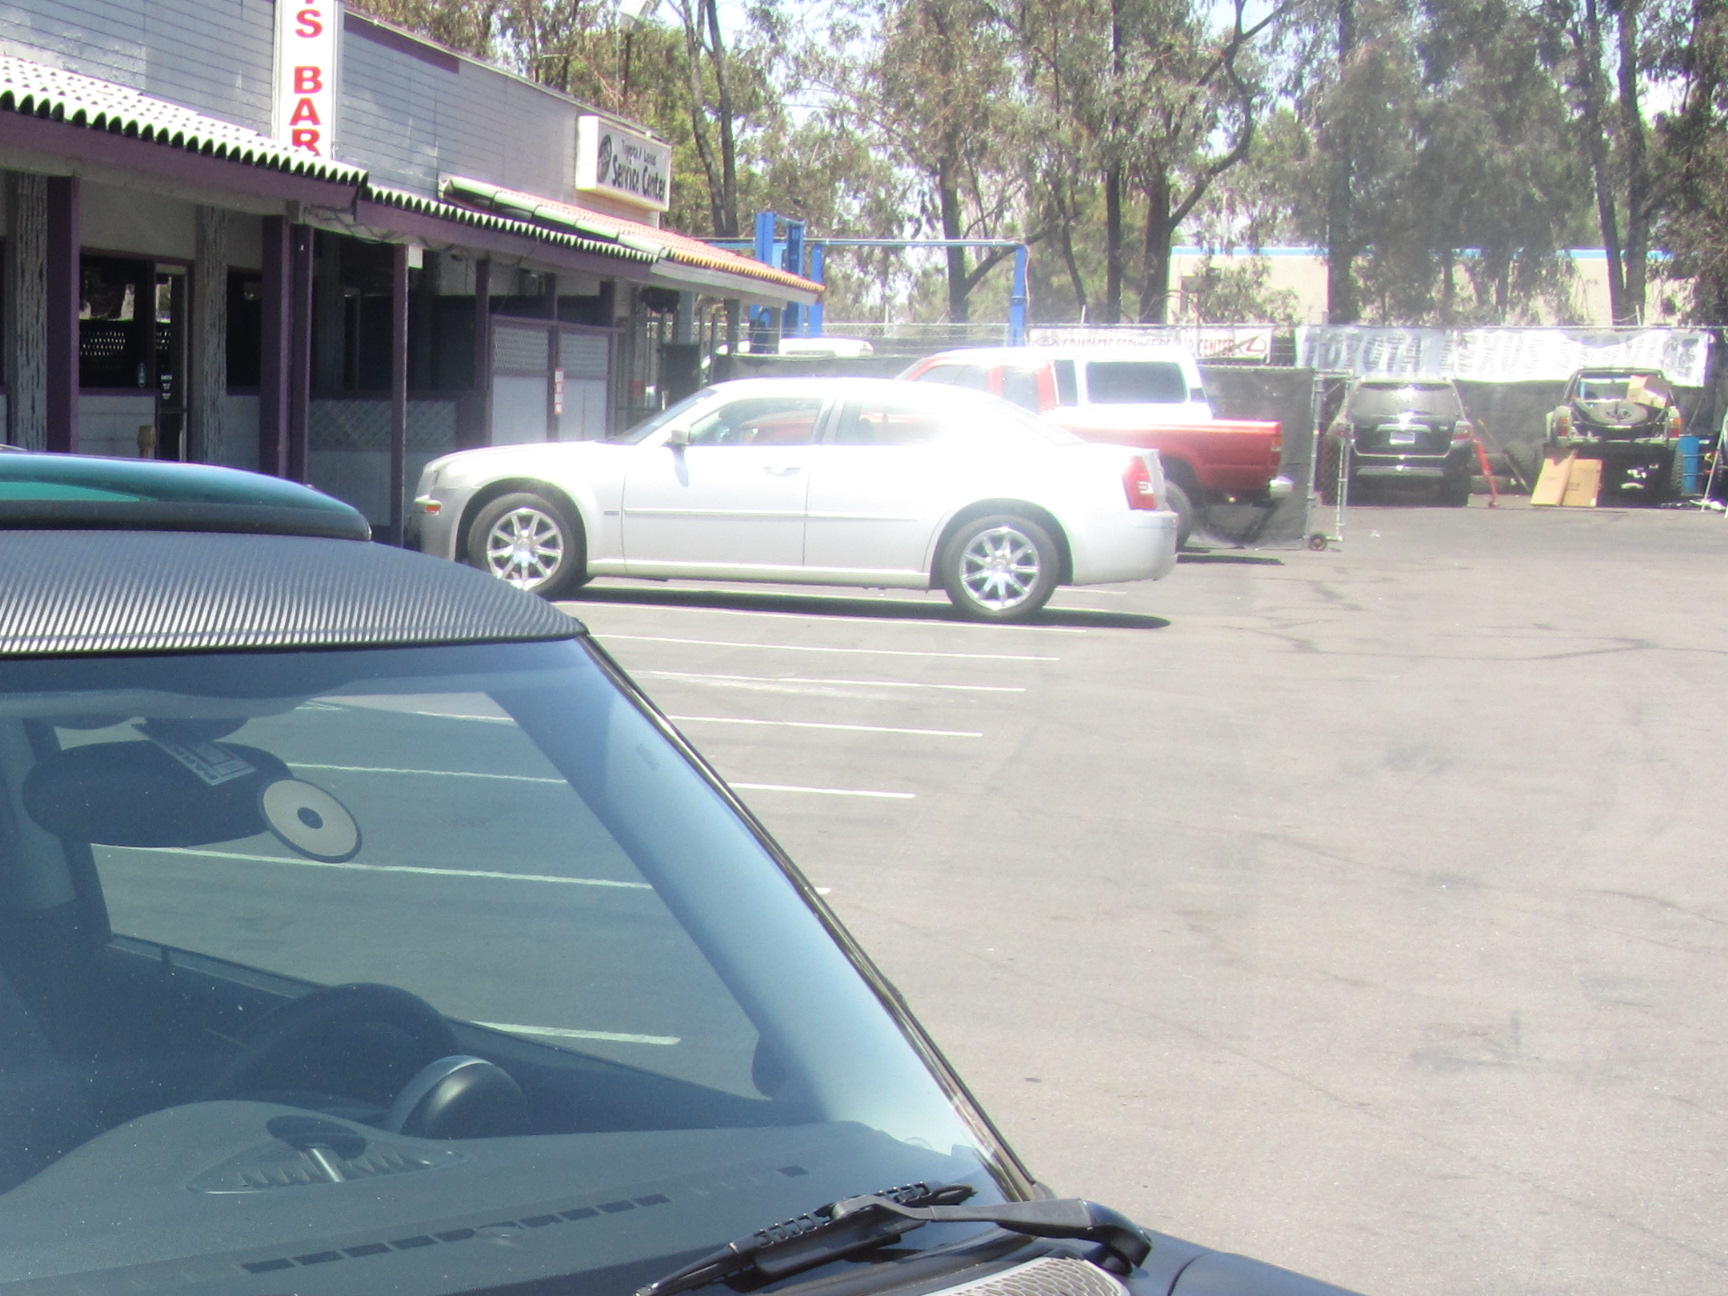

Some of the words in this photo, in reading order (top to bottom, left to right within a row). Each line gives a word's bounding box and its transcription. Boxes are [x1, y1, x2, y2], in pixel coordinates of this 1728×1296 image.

[295, 0, 323, 38] S
[289, 66, 323, 156] BAR
[612, 154, 639, 193] Service
[642, 165, 666, 202] Center
